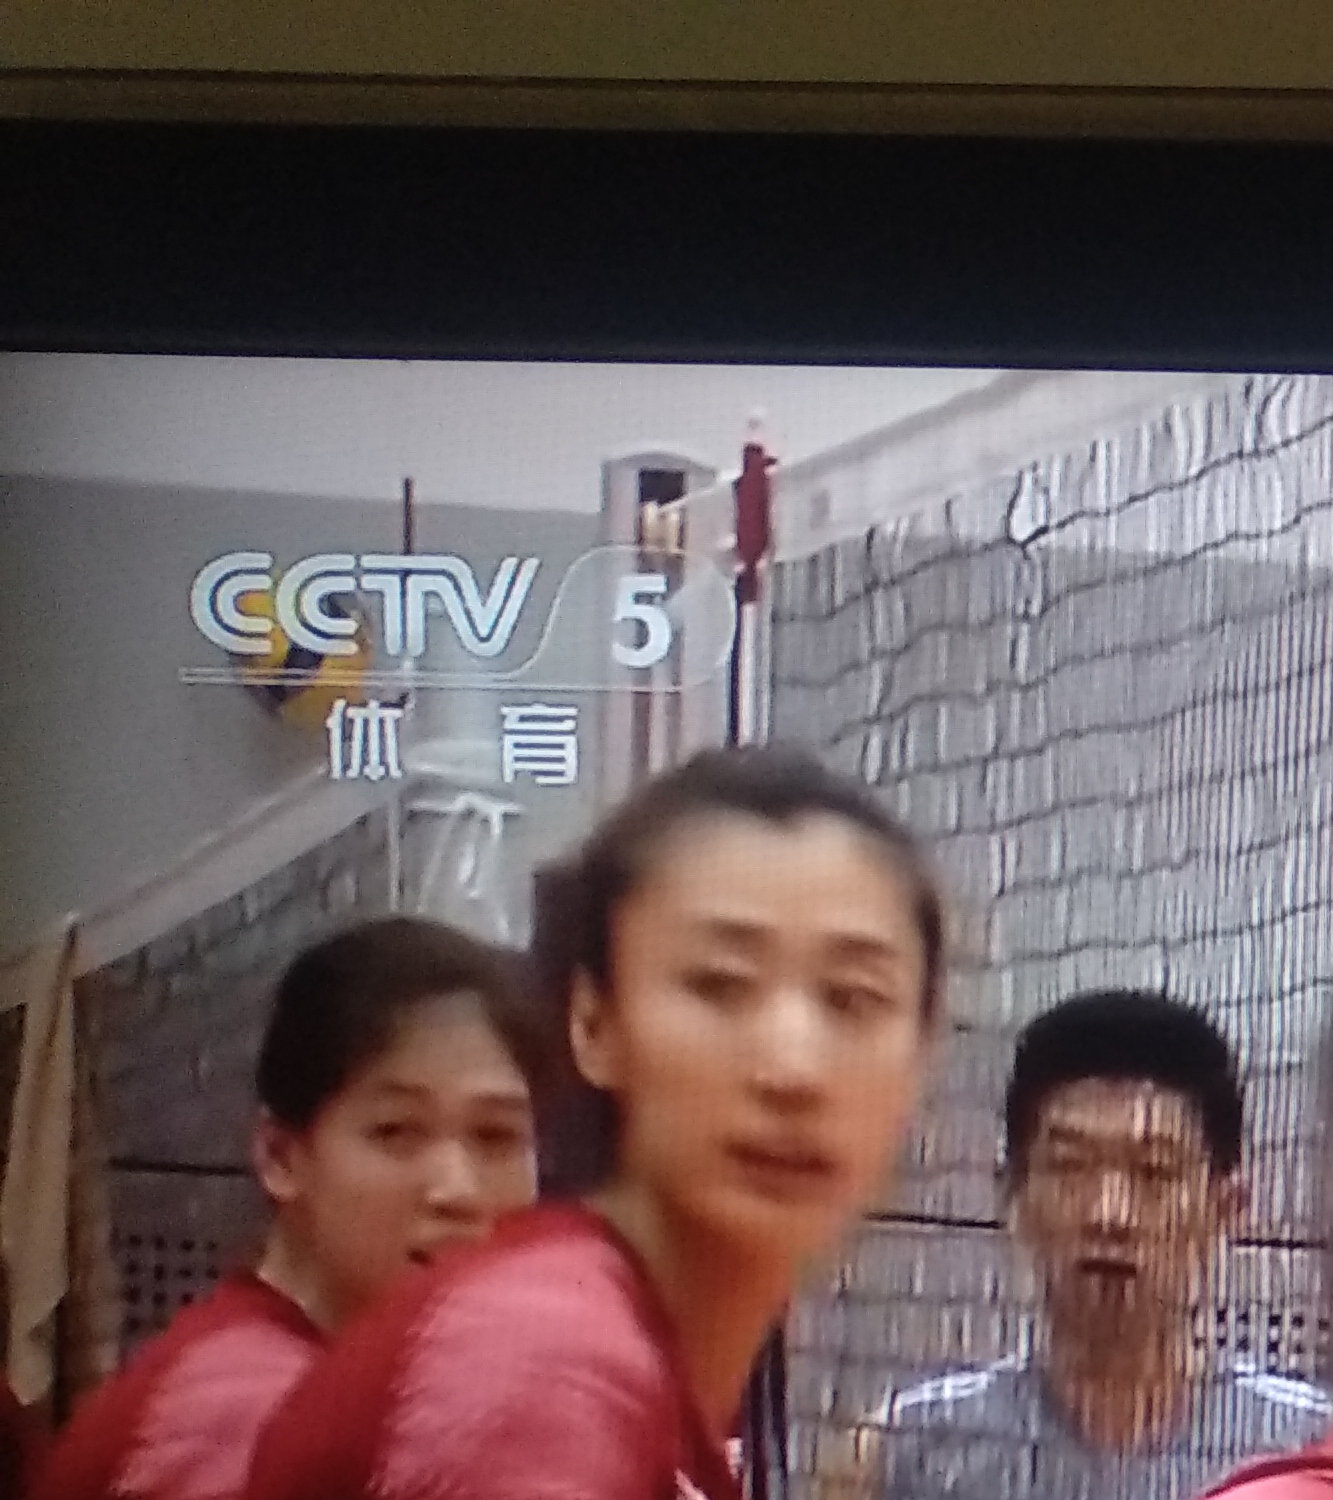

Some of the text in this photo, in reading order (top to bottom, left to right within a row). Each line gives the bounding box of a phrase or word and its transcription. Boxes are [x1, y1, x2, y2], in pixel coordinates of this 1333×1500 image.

[190, 551, 673, 668] CCTV 5
[325, 699, 580, 786] 体育
